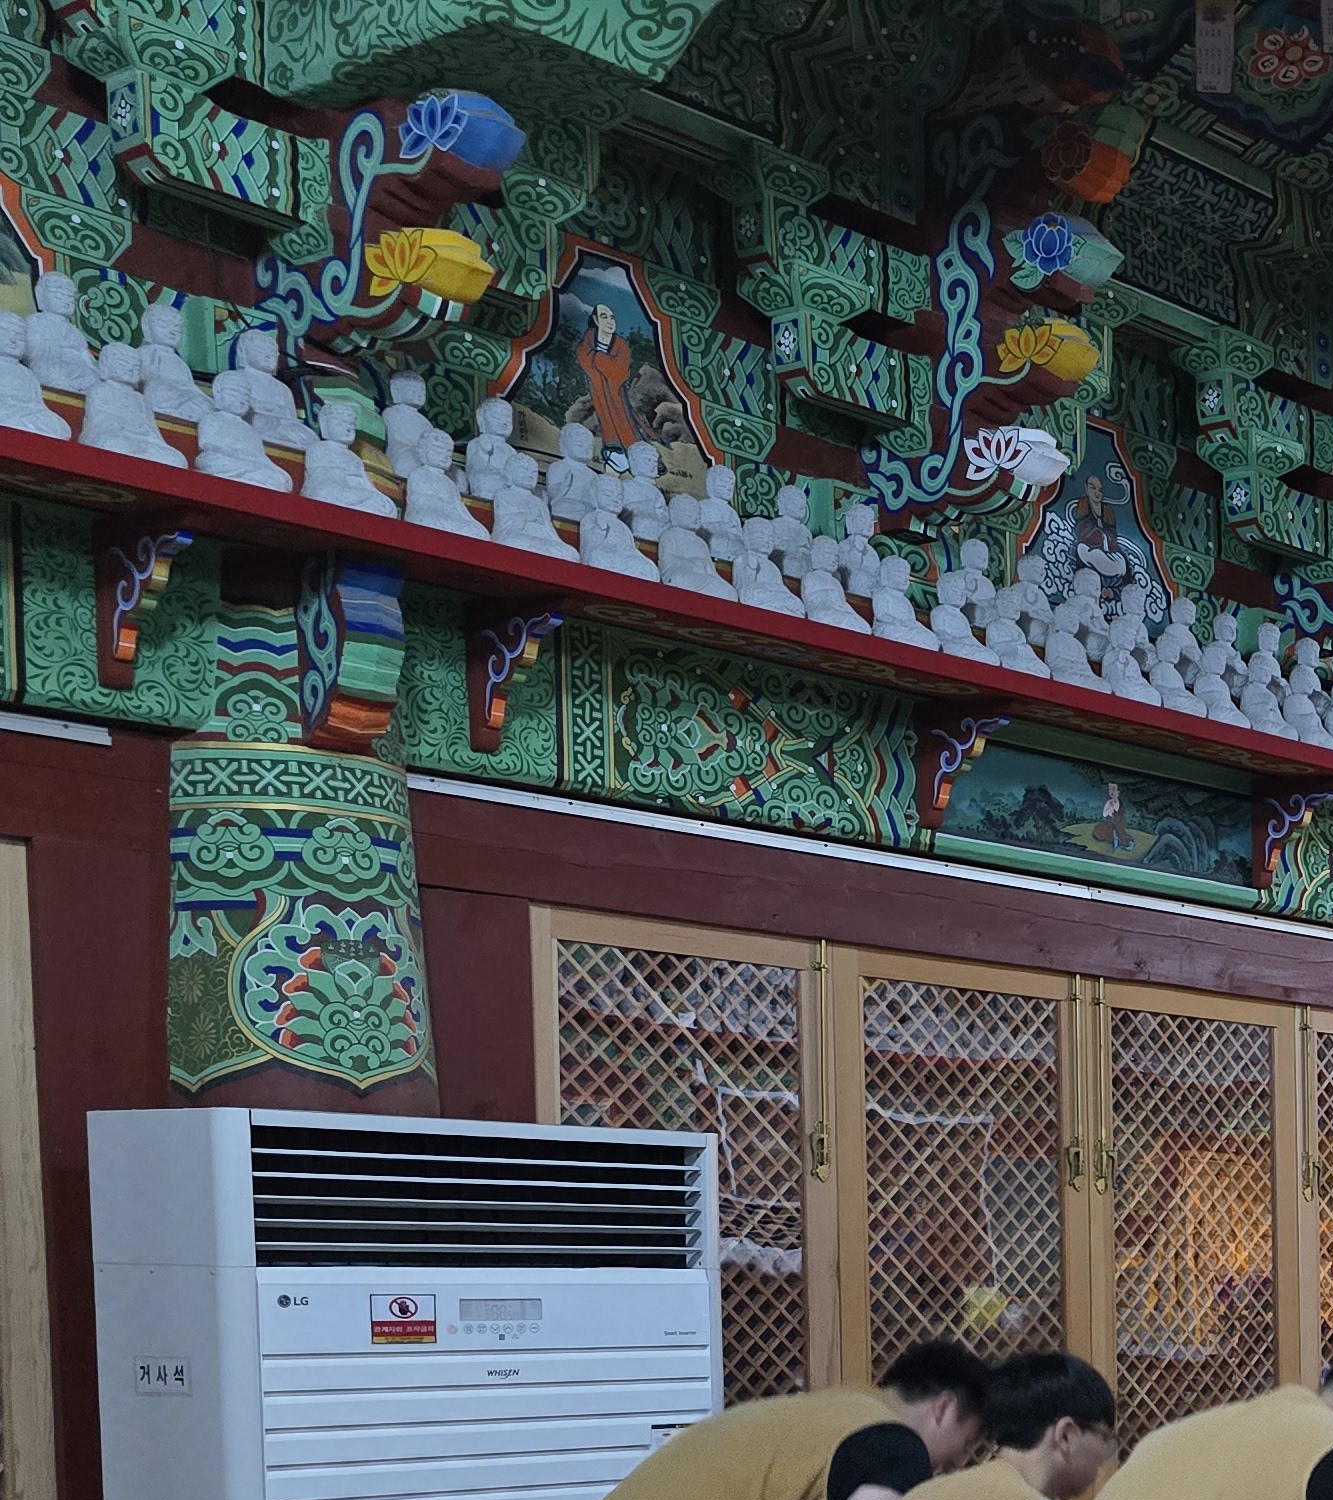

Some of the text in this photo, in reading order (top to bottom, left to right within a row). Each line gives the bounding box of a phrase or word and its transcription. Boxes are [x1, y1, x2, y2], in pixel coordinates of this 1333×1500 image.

[294, 1296, 309, 1306] LG
[139, 1364, 185, 1387] 거사석
[486, 1369, 520, 1380] WHISEN
